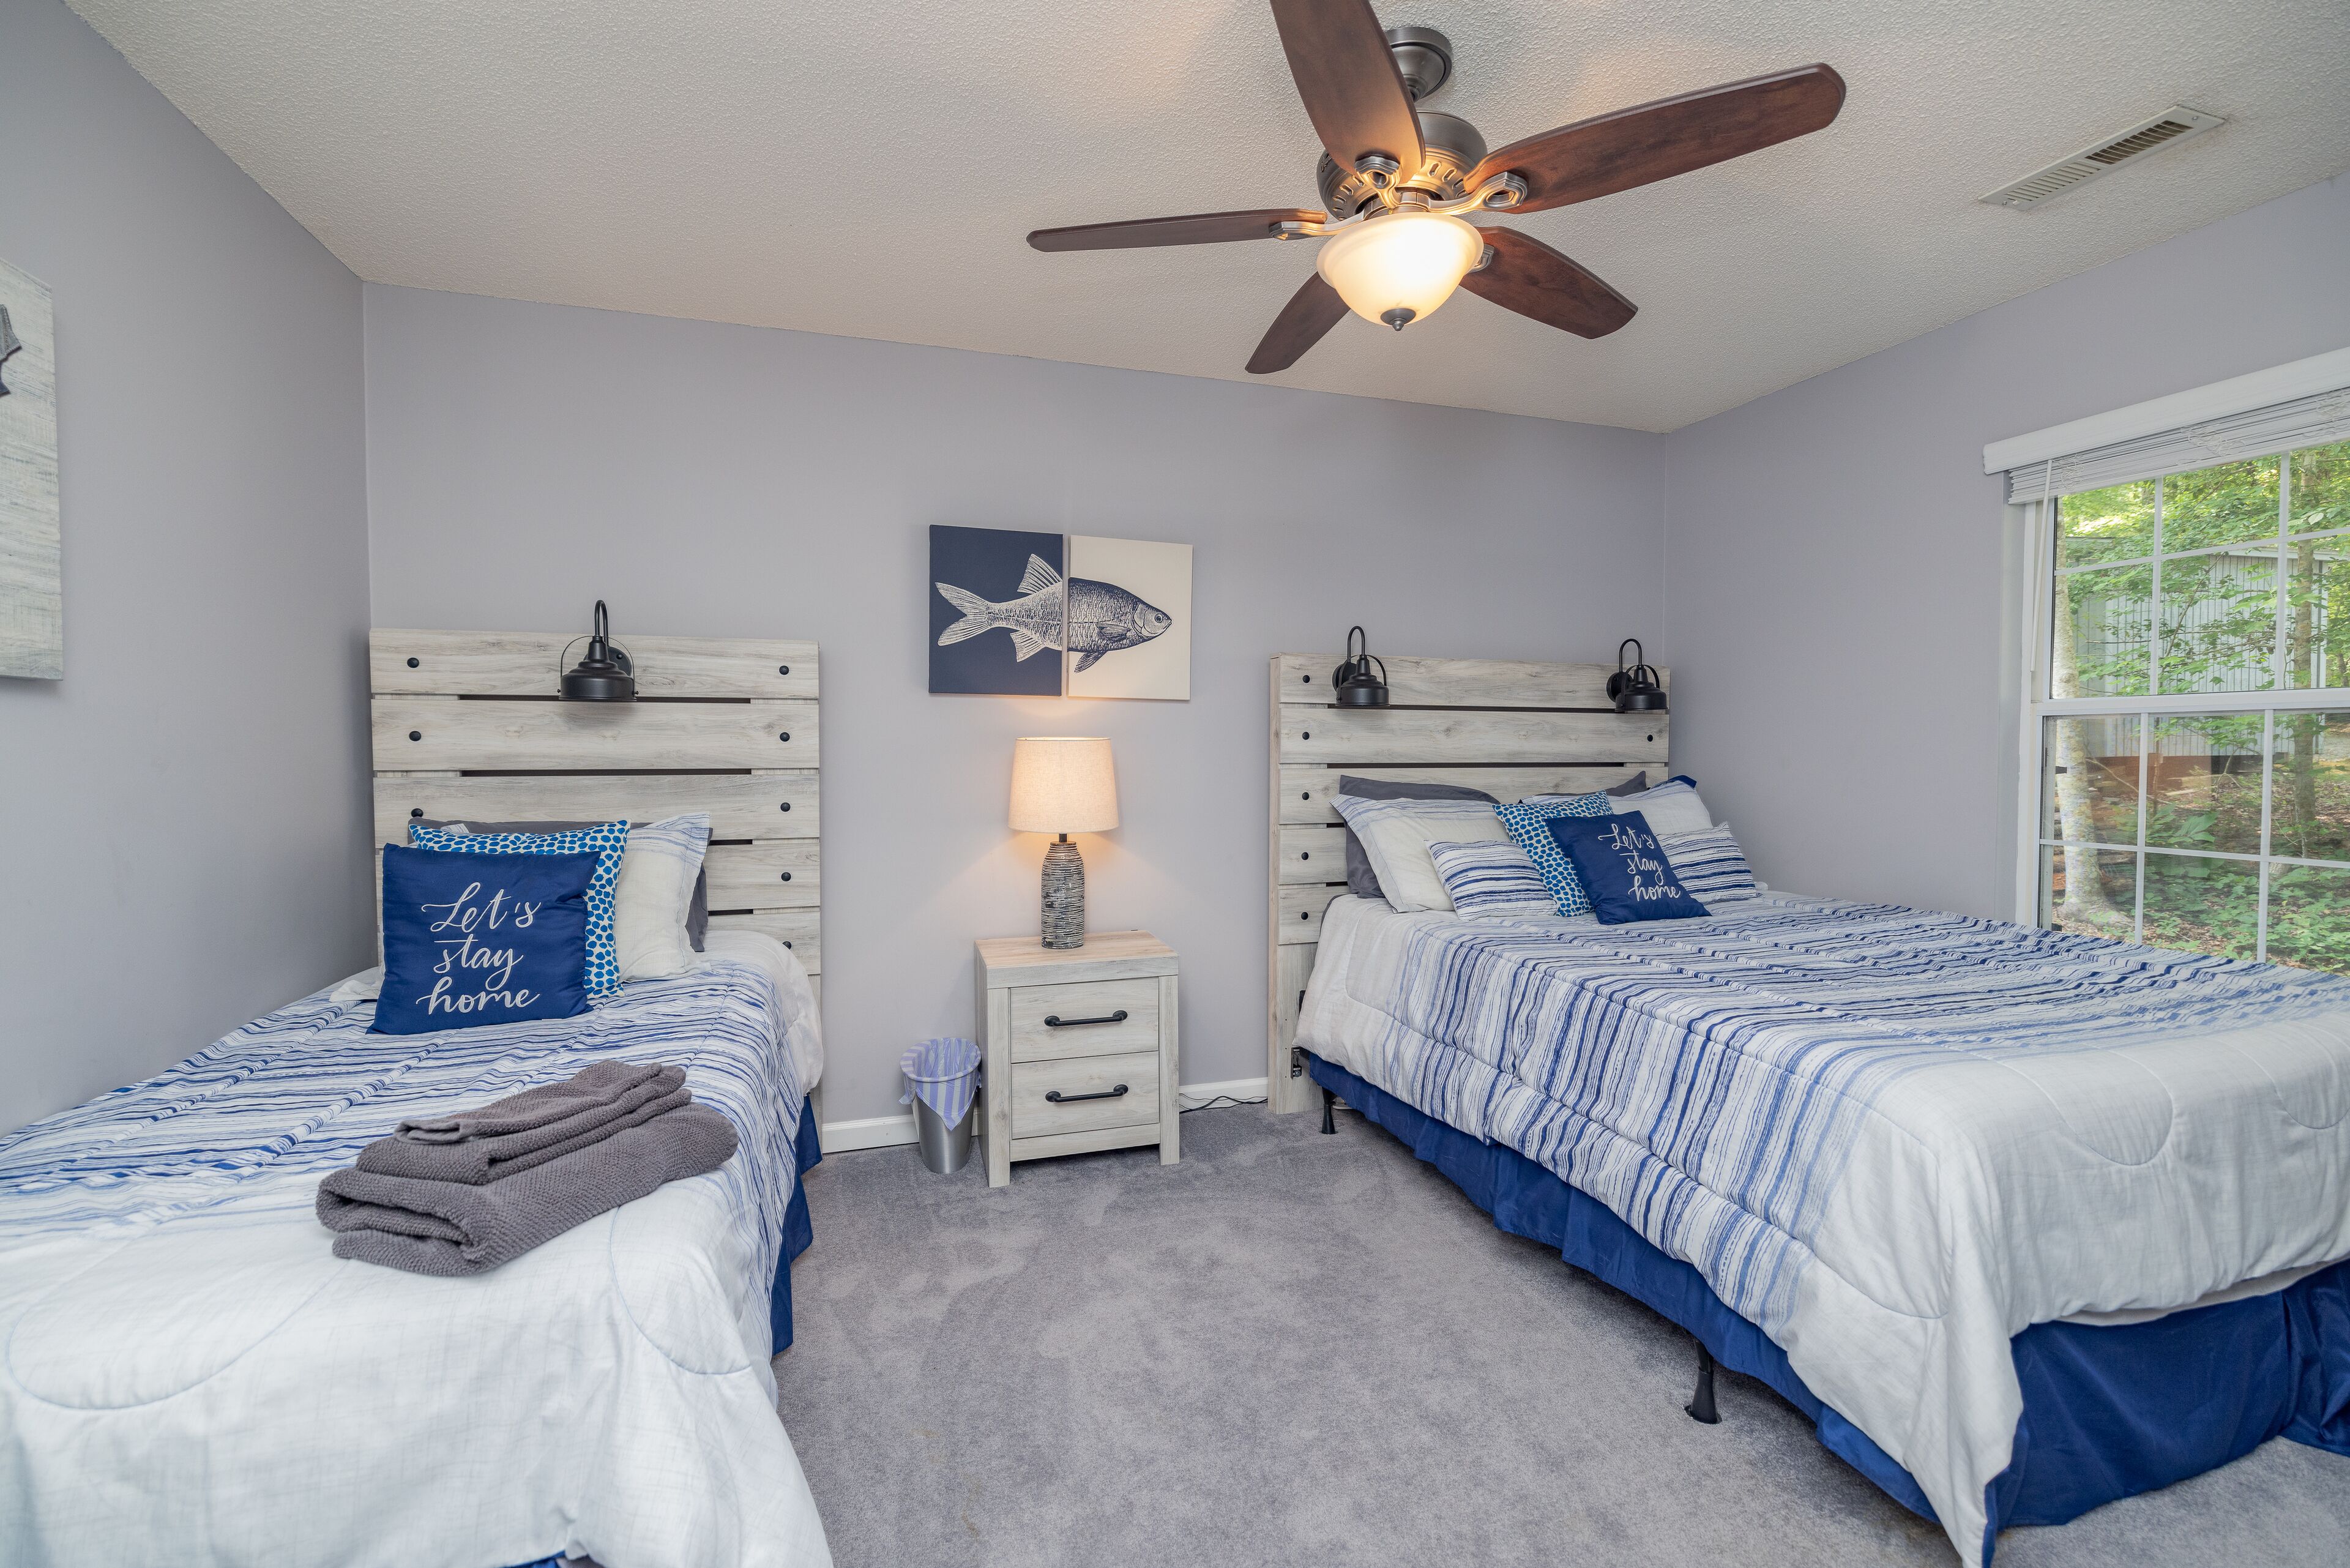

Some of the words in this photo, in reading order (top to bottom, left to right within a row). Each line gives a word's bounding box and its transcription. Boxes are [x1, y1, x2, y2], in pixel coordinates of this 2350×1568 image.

[1598, 824, 1655, 849] Let's
[1619, 849, 1663, 885] stay
[422, 882, 542, 932] Let's
[1628, 875, 1681, 902] home
[434, 934, 524, 991] stay
[416, 976, 540, 1015] home
